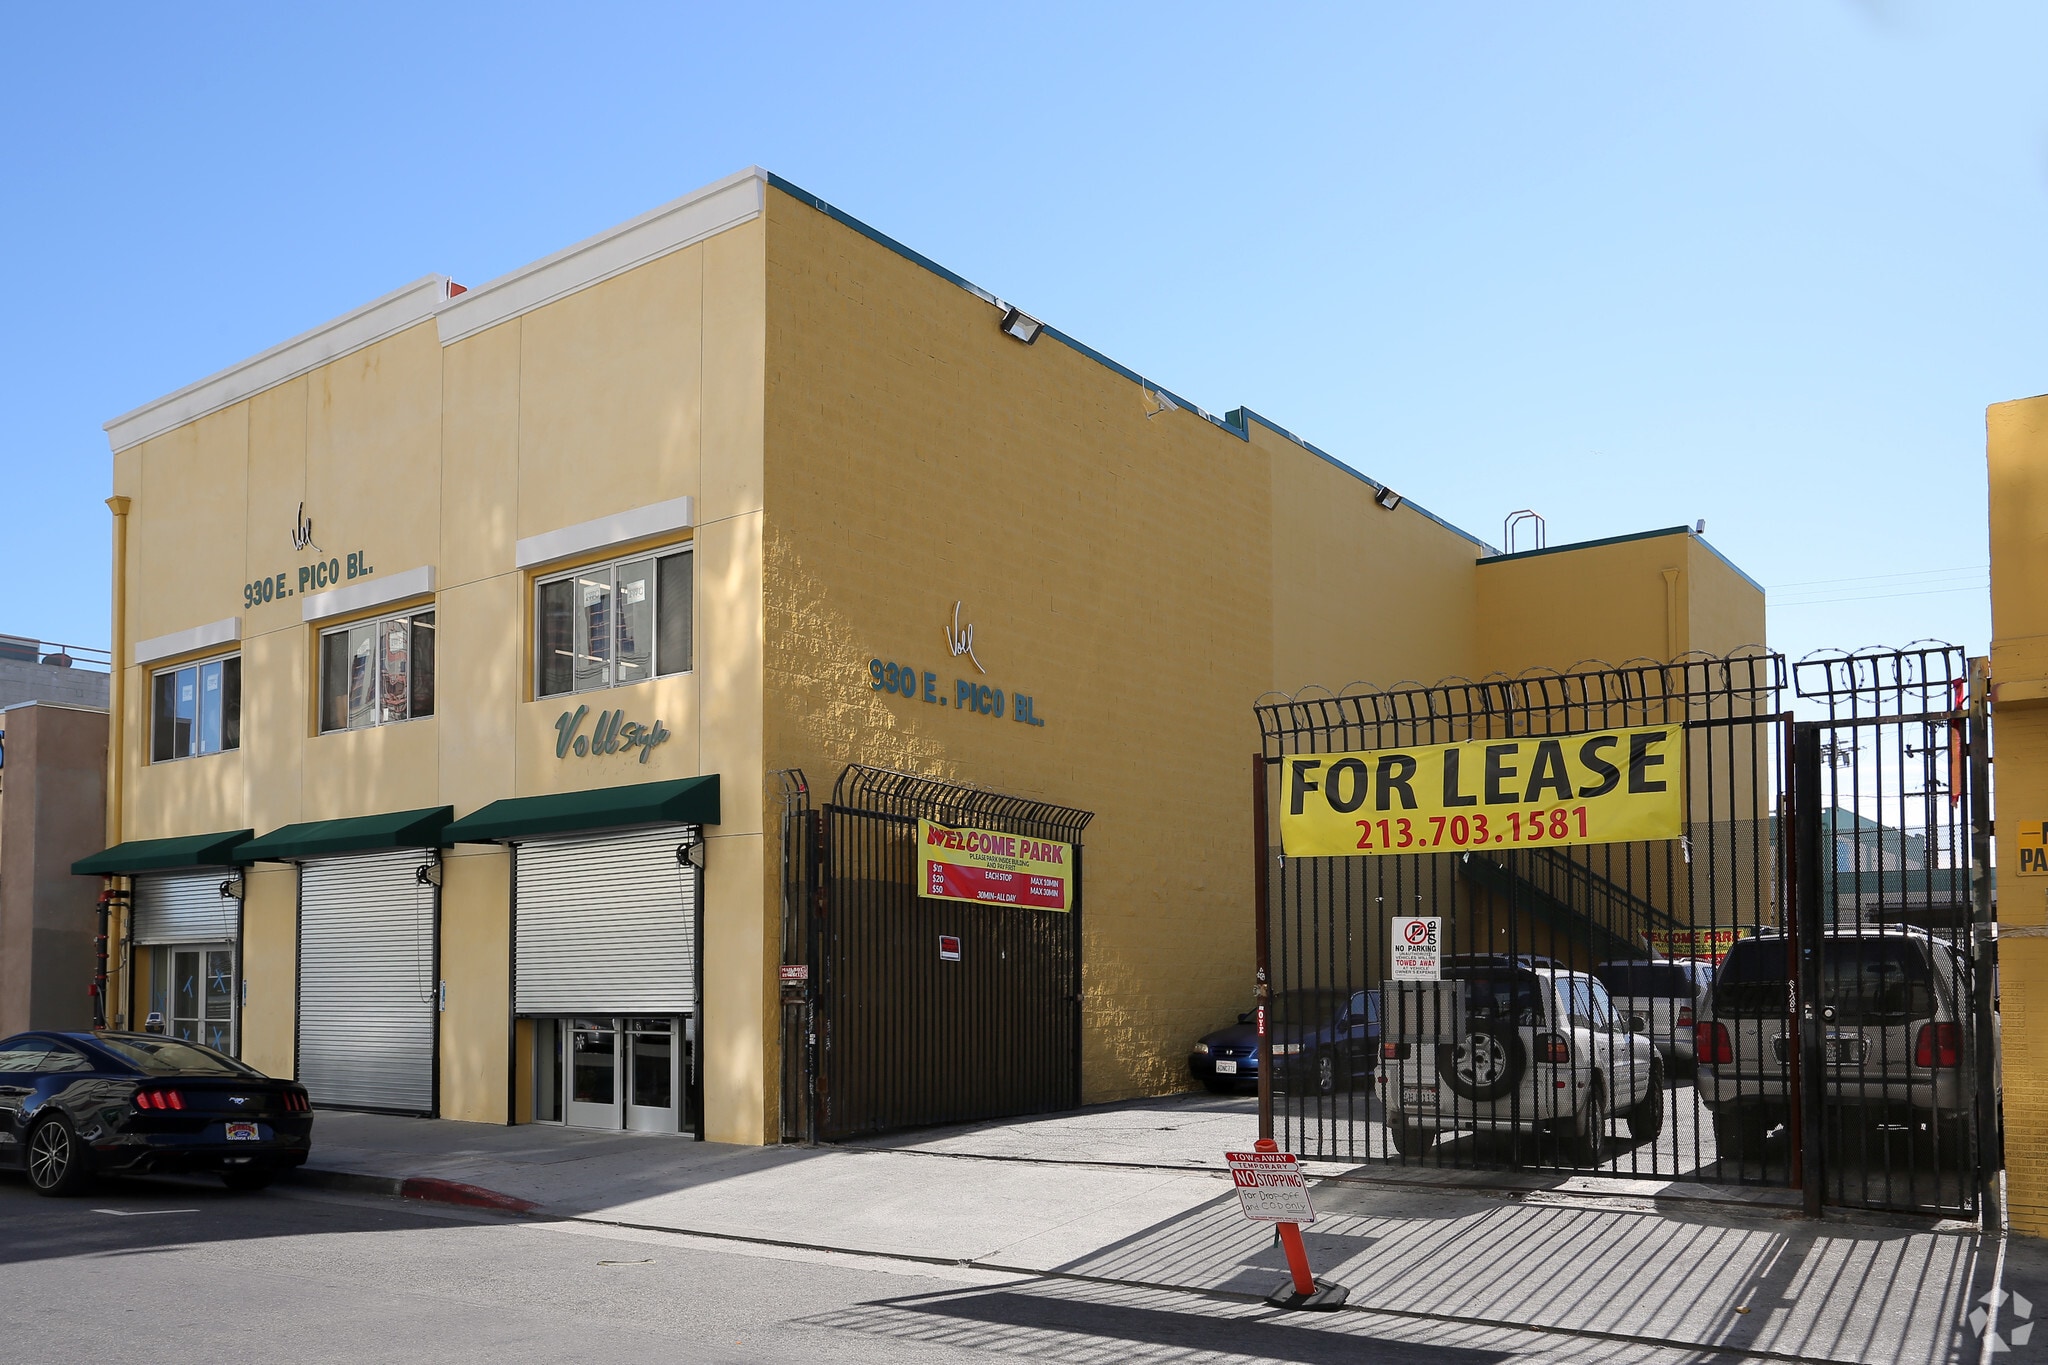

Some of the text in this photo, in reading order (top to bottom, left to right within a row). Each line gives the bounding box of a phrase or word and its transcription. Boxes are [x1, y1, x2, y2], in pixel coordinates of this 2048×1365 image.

[244, 550, 373, 609] 930 E. PICO BL.
[868, 658, 1044, 727] 930 E. PICO BL.
[1290, 731, 1667, 815] FOR LEASE
[1356, 806, 1588, 849] 213.703.1581
[928, 824, 1064, 864] WELCOME PARK
[1012, 859, 1030, 867] BUILDING
[932, 874, 944, 883] $20
[985, 872, 1012, 882] EACH STOP
[1030, 877, 1042, 886] MAX
[1030, 887, 1042, 895] MAX
[1234, 1170, 1301, 1187] NO STOPPING
[1243, 1190, 1256, 1200] For
[1285, 1202, 1306, 1210] only
